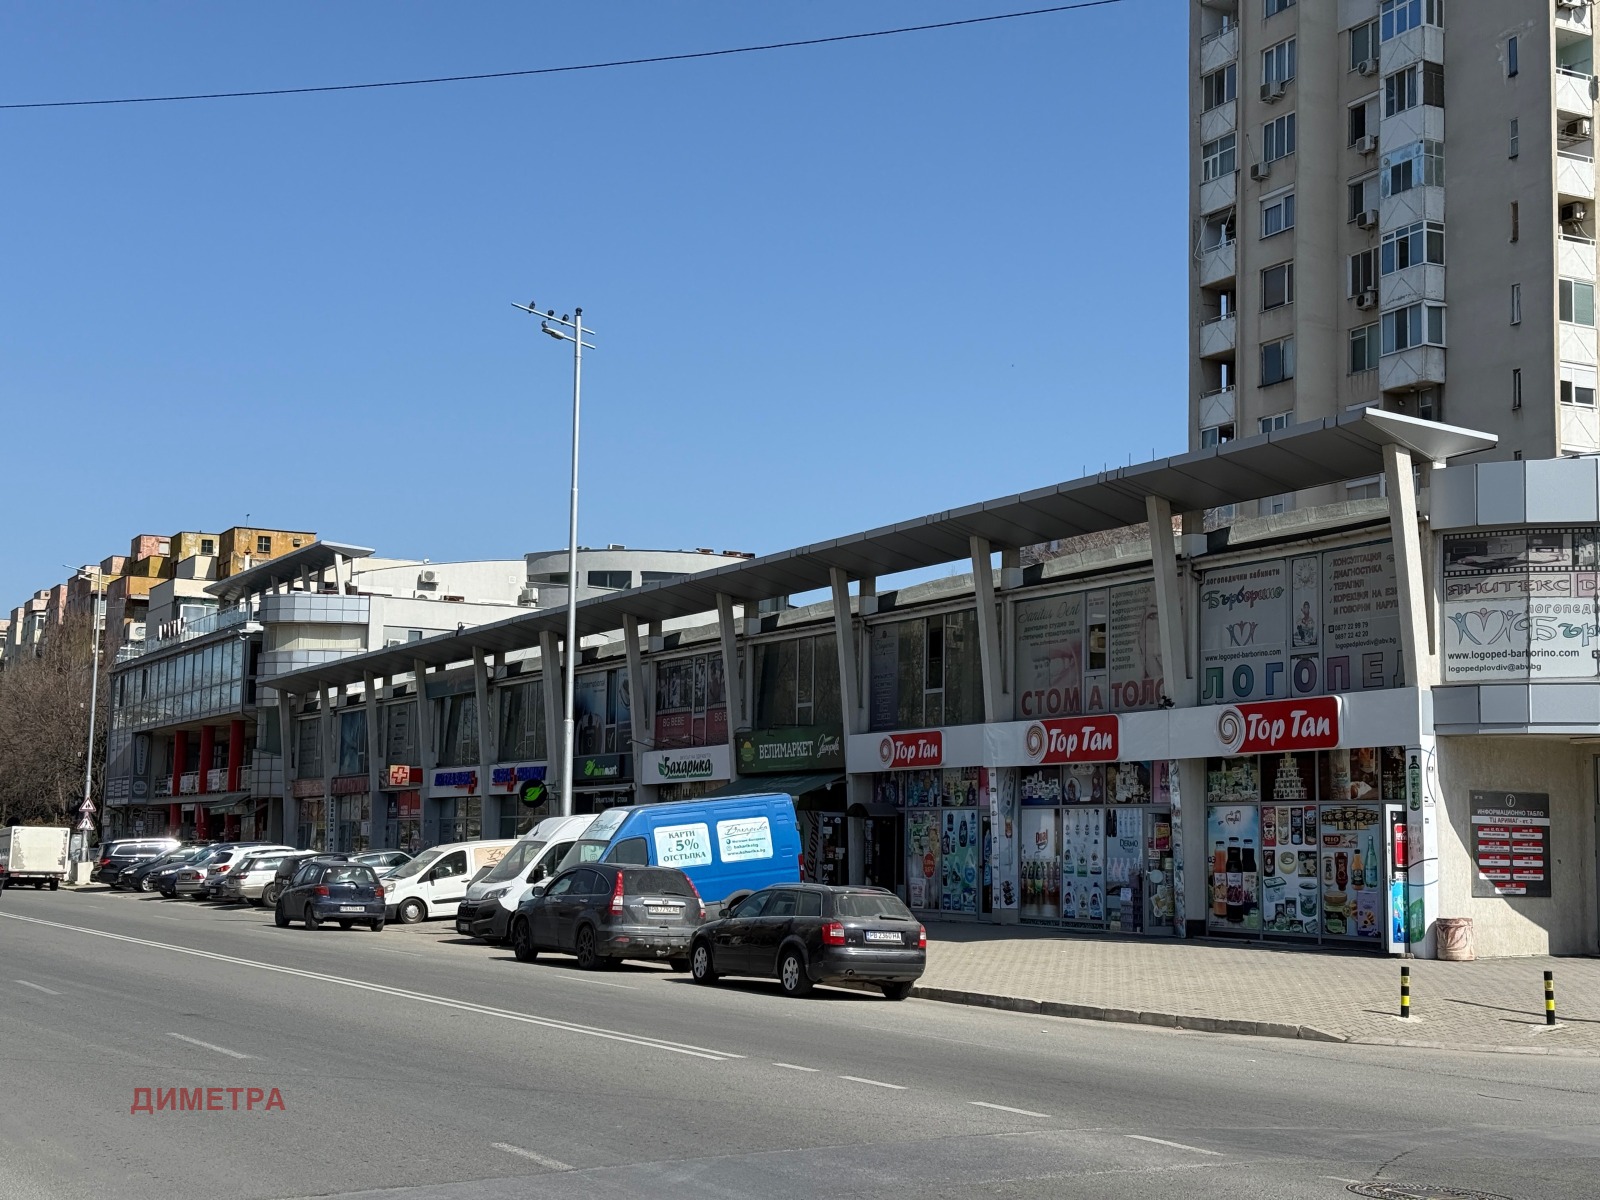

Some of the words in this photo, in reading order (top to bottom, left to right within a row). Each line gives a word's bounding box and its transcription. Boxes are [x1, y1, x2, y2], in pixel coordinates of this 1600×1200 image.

[1333, 552, 1382, 567] КОНСУЛТАЦИЯ
[1333, 566, 1382, 578] ДИАГНОСТИКА
[1334, 579, 1364, 591] ТЕРАПИЯ
[1448, 579, 1570, 596] ЯНИТЕКС
[1333, 590, 1369, 603] КОРЕКЦИЯ
[1372, 589, 1382, 599] НА
[1514, 616, 1600, 647] Бър
[1205, 648, 1282, 662] www.logoped-barborino.com
[1448, 648, 1580, 660] www.logoped-barborino.com
[1247, 713, 1285, 746] Top
[1290, 709, 1331, 737] Tan
[1049, 728, 1078, 758] Top
[1081, 726, 1113, 751] Tan
[759, 741, 814, 759] ВЕЛИМАРКЕТ
[894, 740, 916, 764] Top
[917, 738, 938, 758] Tan
[664, 757, 711, 778] Бахарика
[1477, 809, 1526, 817] ИНФОРМАЦИОННО
[668, 830, 695, 839] КАРТИ
[675, 839, 699, 852] 5%
[663, 851, 706, 862] ОТСТЪПКА
